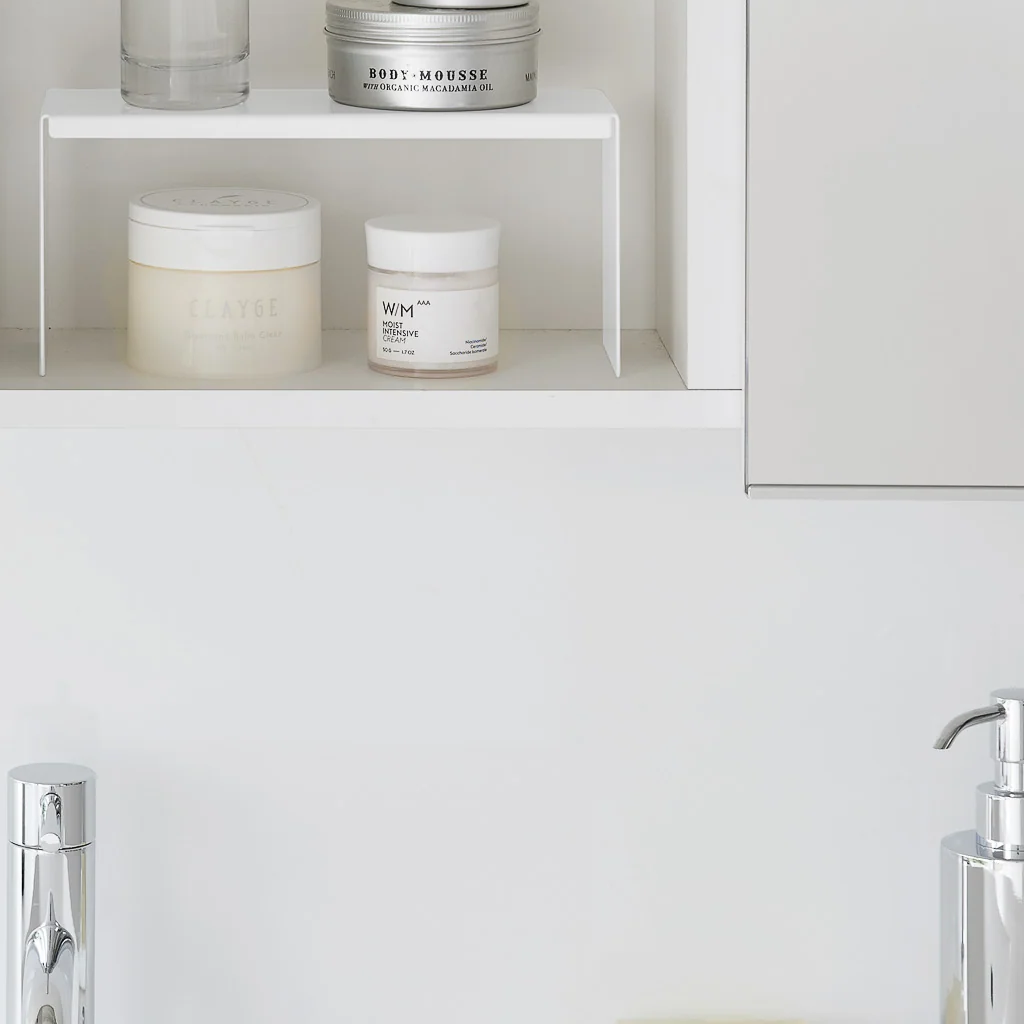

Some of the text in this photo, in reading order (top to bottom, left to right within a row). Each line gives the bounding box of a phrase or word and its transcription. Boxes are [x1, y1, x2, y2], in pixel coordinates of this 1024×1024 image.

[369, 68, 488, 81] BODY MOUSSE
[380, 83, 420, 92] ORGANIC
[422, 84, 477, 92] MACADAMIA
[479, 83, 493, 91] OIL
[189, 298, 278, 318] CLAYGE
[382, 300, 414, 318] W/M
[382, 320, 403, 329] MOIST
[382, 328, 418, 337] INTENSIVE
[382, 335, 406, 344] CREAM
